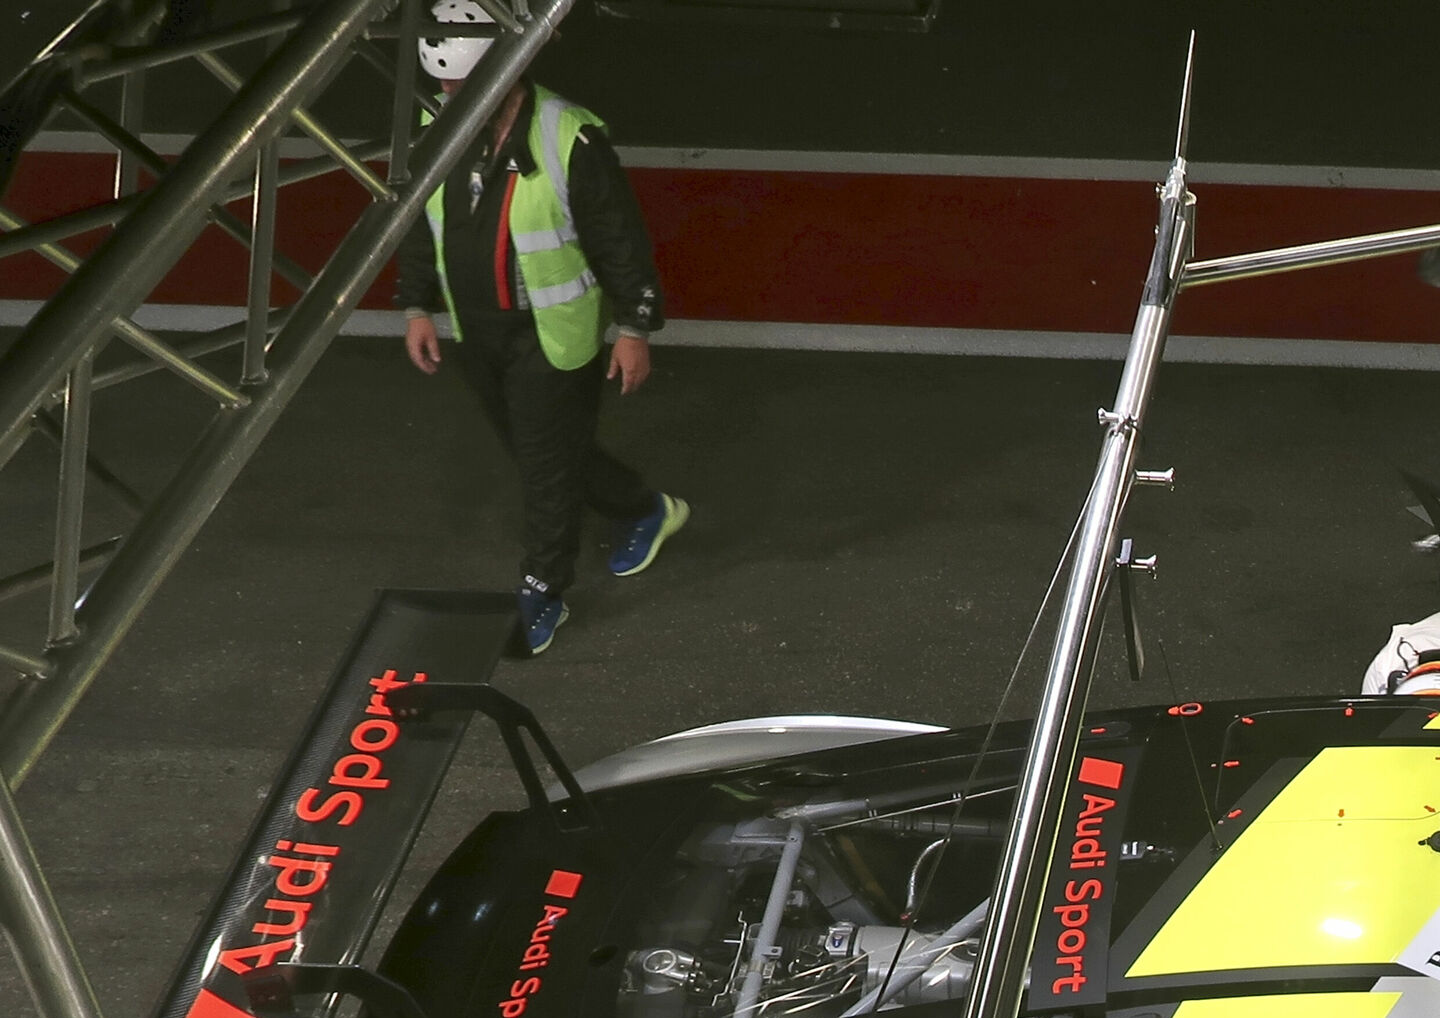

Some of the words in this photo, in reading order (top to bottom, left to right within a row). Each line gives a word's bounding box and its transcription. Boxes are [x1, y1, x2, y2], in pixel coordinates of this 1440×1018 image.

[217, 840, 342, 976] Audi
[295, 669, 429, 827] Sport
[1069, 793, 1117, 869] Audi
[519, 904, 569, 970] Audi
[1051, 878, 1103, 995] Sport
